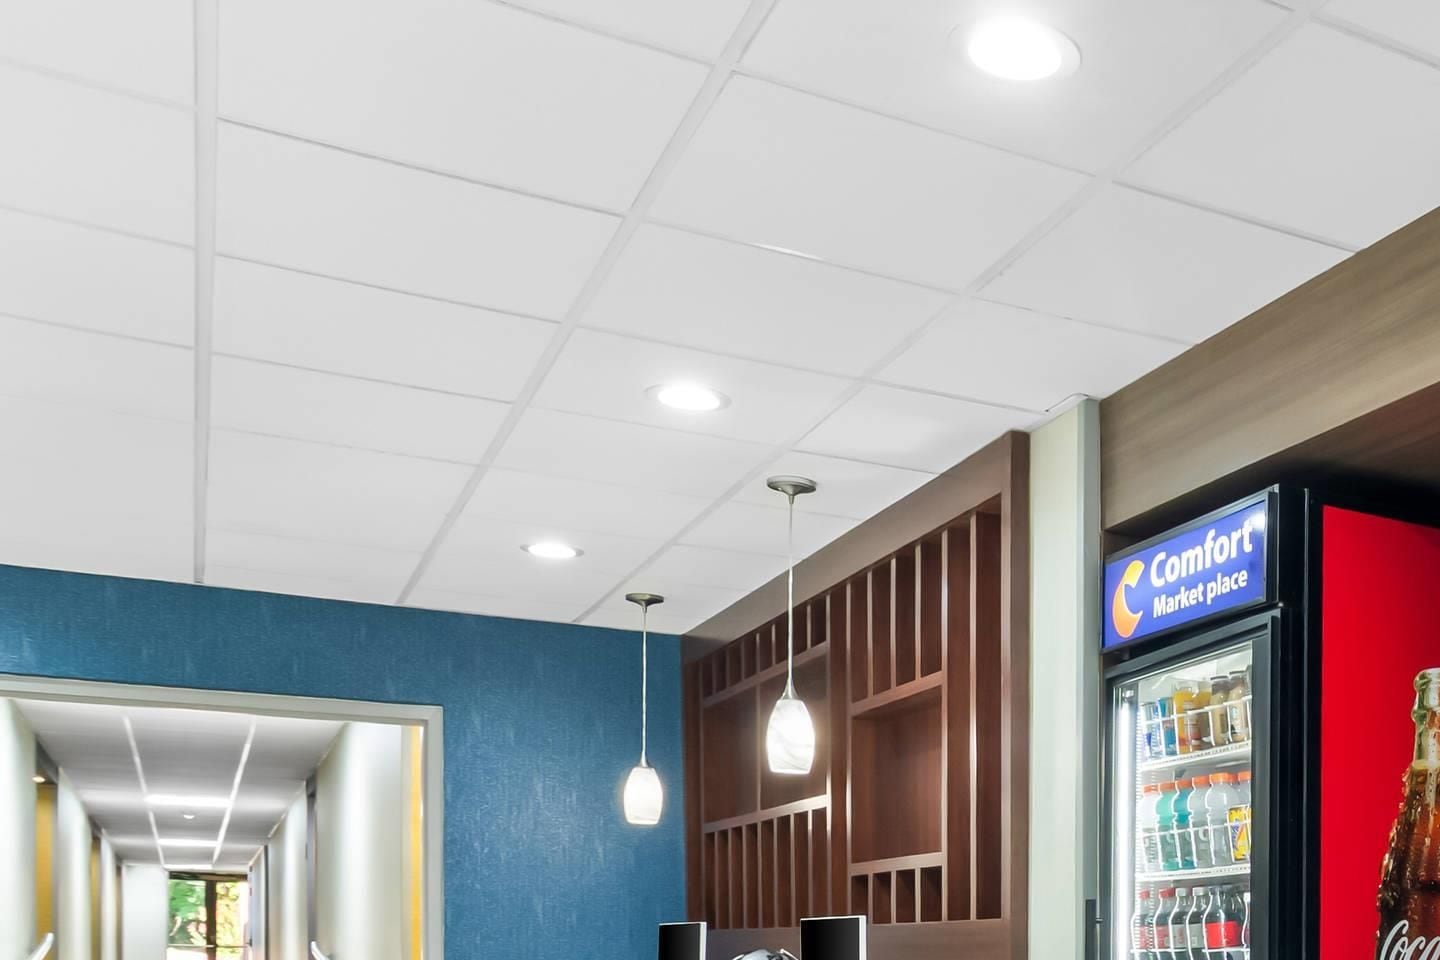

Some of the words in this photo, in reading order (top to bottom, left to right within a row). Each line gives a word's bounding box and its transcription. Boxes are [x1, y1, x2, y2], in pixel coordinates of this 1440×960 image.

[1150, 520, 1253, 588] Comfort
[1152, 582, 1204, 618] Market
[1206, 570, 1248, 605] place
